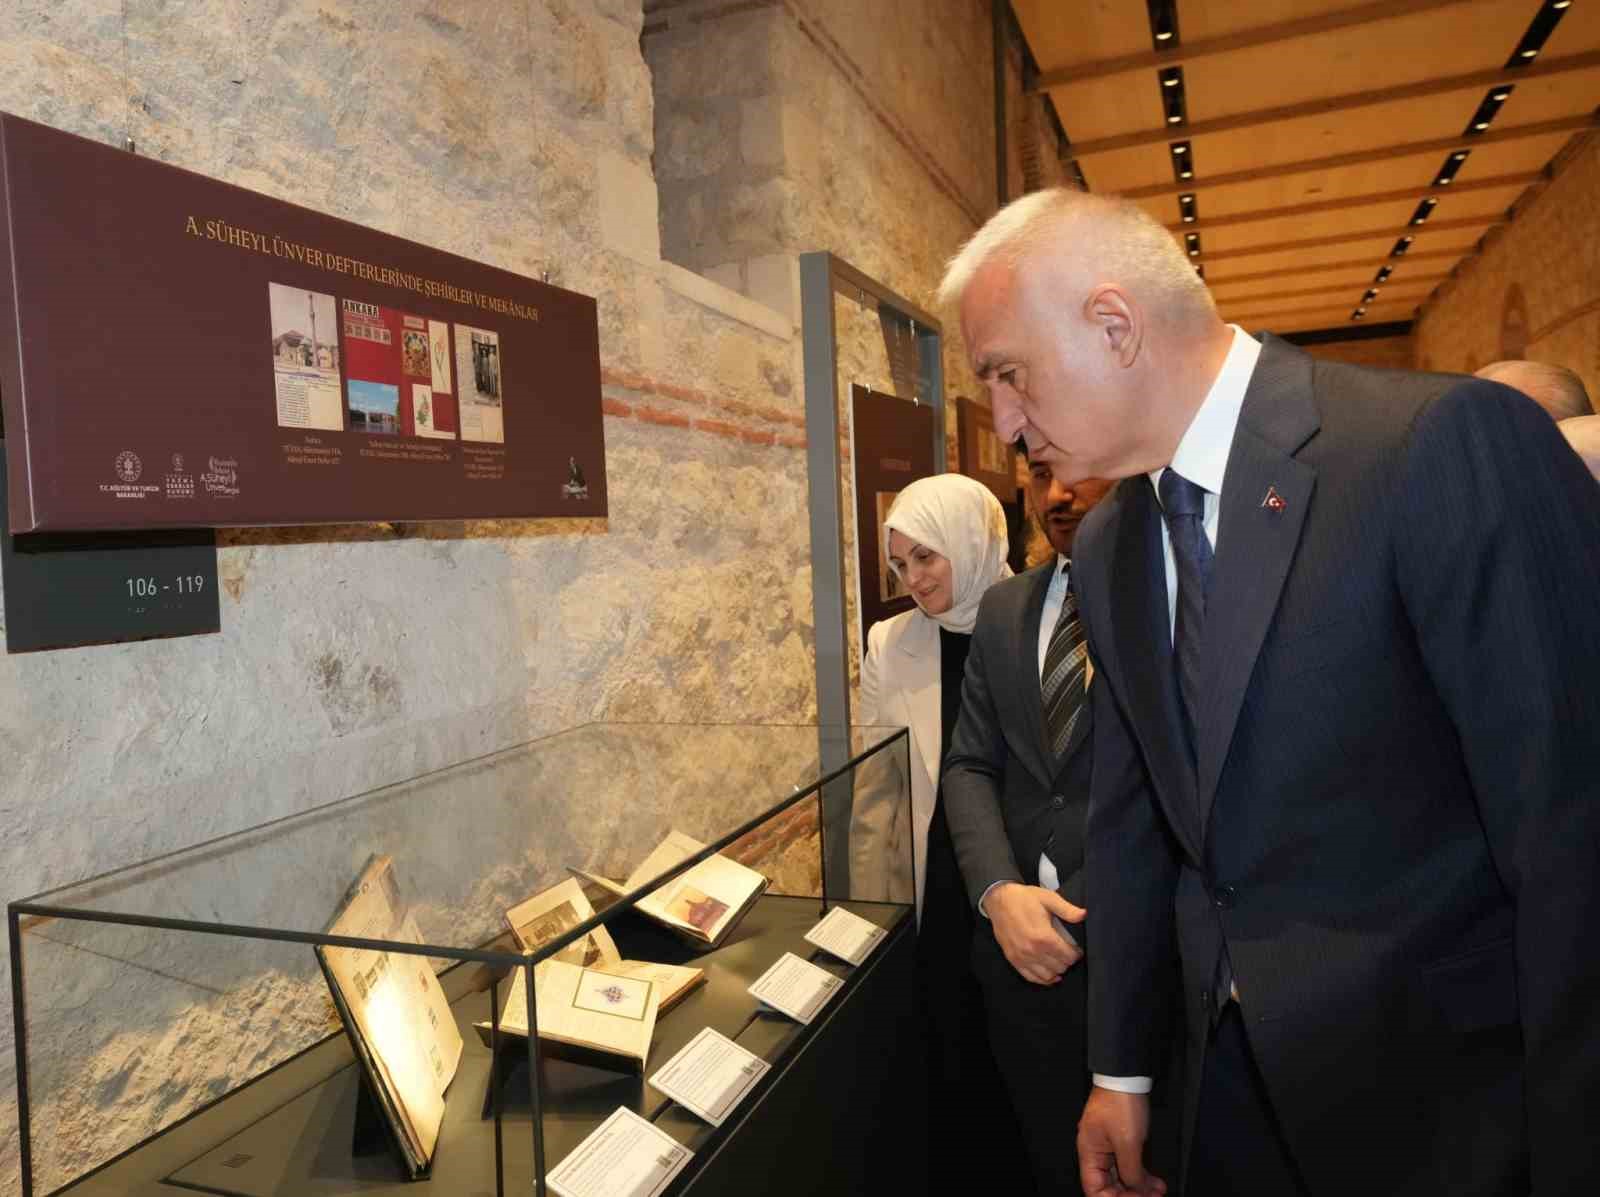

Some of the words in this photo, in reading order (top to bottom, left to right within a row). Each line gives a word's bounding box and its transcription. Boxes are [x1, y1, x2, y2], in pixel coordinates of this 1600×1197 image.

[185, 216, 203, 236] A.
[206, 220, 271, 253] SÜHEYL
[272, 235, 324, 266] ÜNVER
[326, 253, 424, 293] DEFTERLERİNDE
[424, 279, 473, 306] ŞEHİRLER
[474, 292, 487, 309] VE
[126, 577, 157, 597] 106
[176, 575, 204, 593] 119
